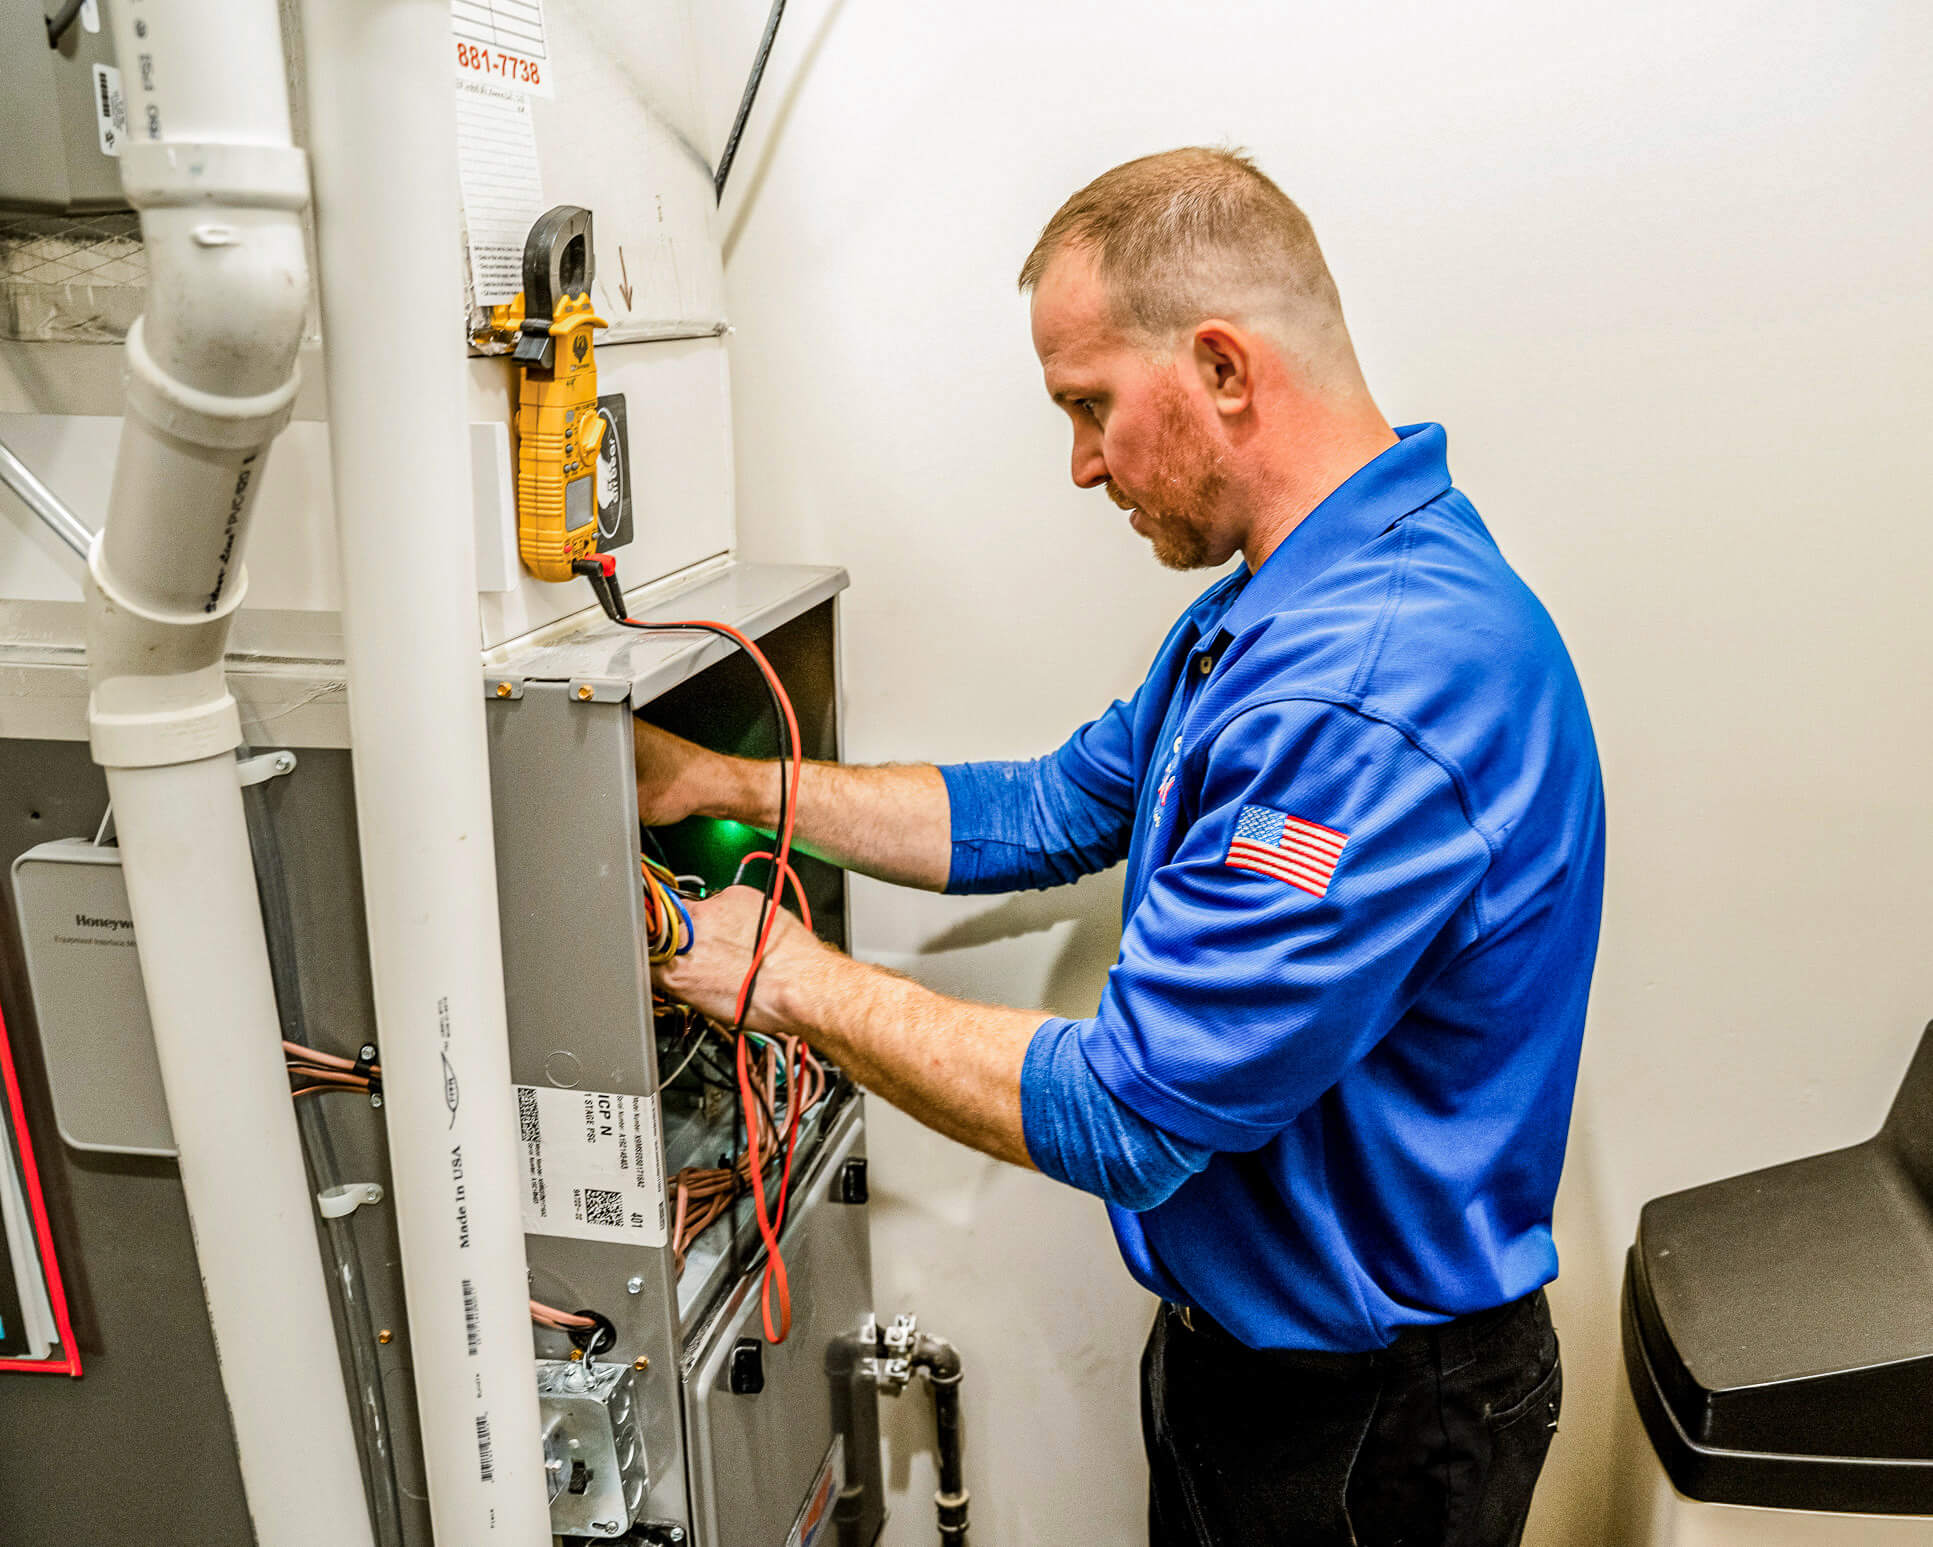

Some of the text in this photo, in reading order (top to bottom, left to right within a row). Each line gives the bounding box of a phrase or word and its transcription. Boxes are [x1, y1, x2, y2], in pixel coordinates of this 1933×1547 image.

[457, 43, 541, 85] 881-7738
[584, 1099, 594, 1126] STAGE
[598, 1094, 613, 1136] ICP N
[586, 1127, 596, 1144] PSC
[451, 1144, 464, 1181] USA
[456, 1205, 470, 1249] Made
[630, 1212, 643, 1228] 401
